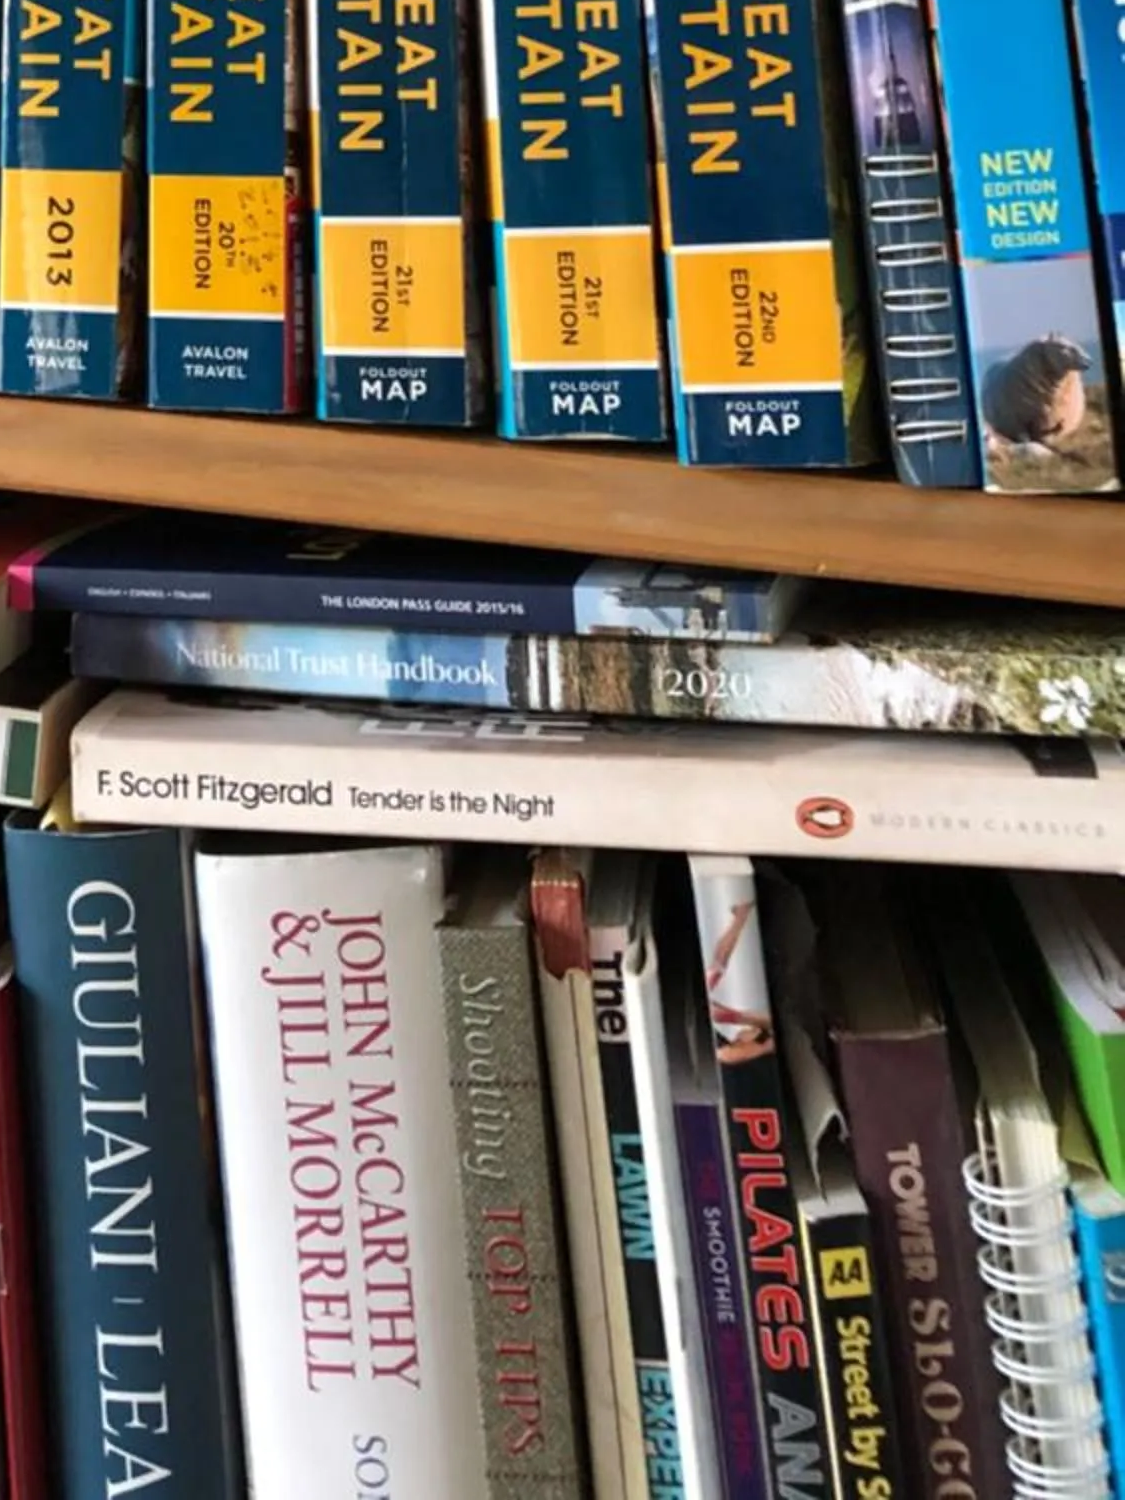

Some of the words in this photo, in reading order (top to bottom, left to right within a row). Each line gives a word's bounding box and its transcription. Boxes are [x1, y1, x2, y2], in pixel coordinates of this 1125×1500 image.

[46, 198, 74, 287] 2013
[194, 198, 211, 289] EDITION
[370, 240, 389, 334] EDITION
[183, 345, 249, 362] AVALON
[184, 364, 246, 380] TRAVEL
[726, 401, 800, 413] FOLDOUT
[729, 415, 801, 437] MAP
[322, 595, 343, 608] THE
[347, 596, 398, 611] LONDON
[402, 598, 430, 612] PASS
[434, 599, 472, 614] GUIDE
[476, 600, 525, 615] 2015/16
[177, 642, 280, 673] National
[286, 650, 349, 677] Trust
[356, 653, 499, 687] Handbook
[98, 772, 113, 796] F.
[119, 772, 188, 799] Scott
[197, 775, 333, 809] Fitzgerald
[349, 787, 423, 811] Tender
[430, 790, 444, 811] is
[450, 791, 487, 814] the
[493, 794, 555, 820] Night
[271, 910, 311, 959] &
[322, 908, 394, 1059] JOHN
[262, 966, 331, 1084] JILL
[66, 878, 158, 1273] GIULIANI
[285, 1097, 357, 1394] MORRELL
[349, 1080, 421, 1391] McCARTHY
[732, 1107, 810, 1370] PILATES
